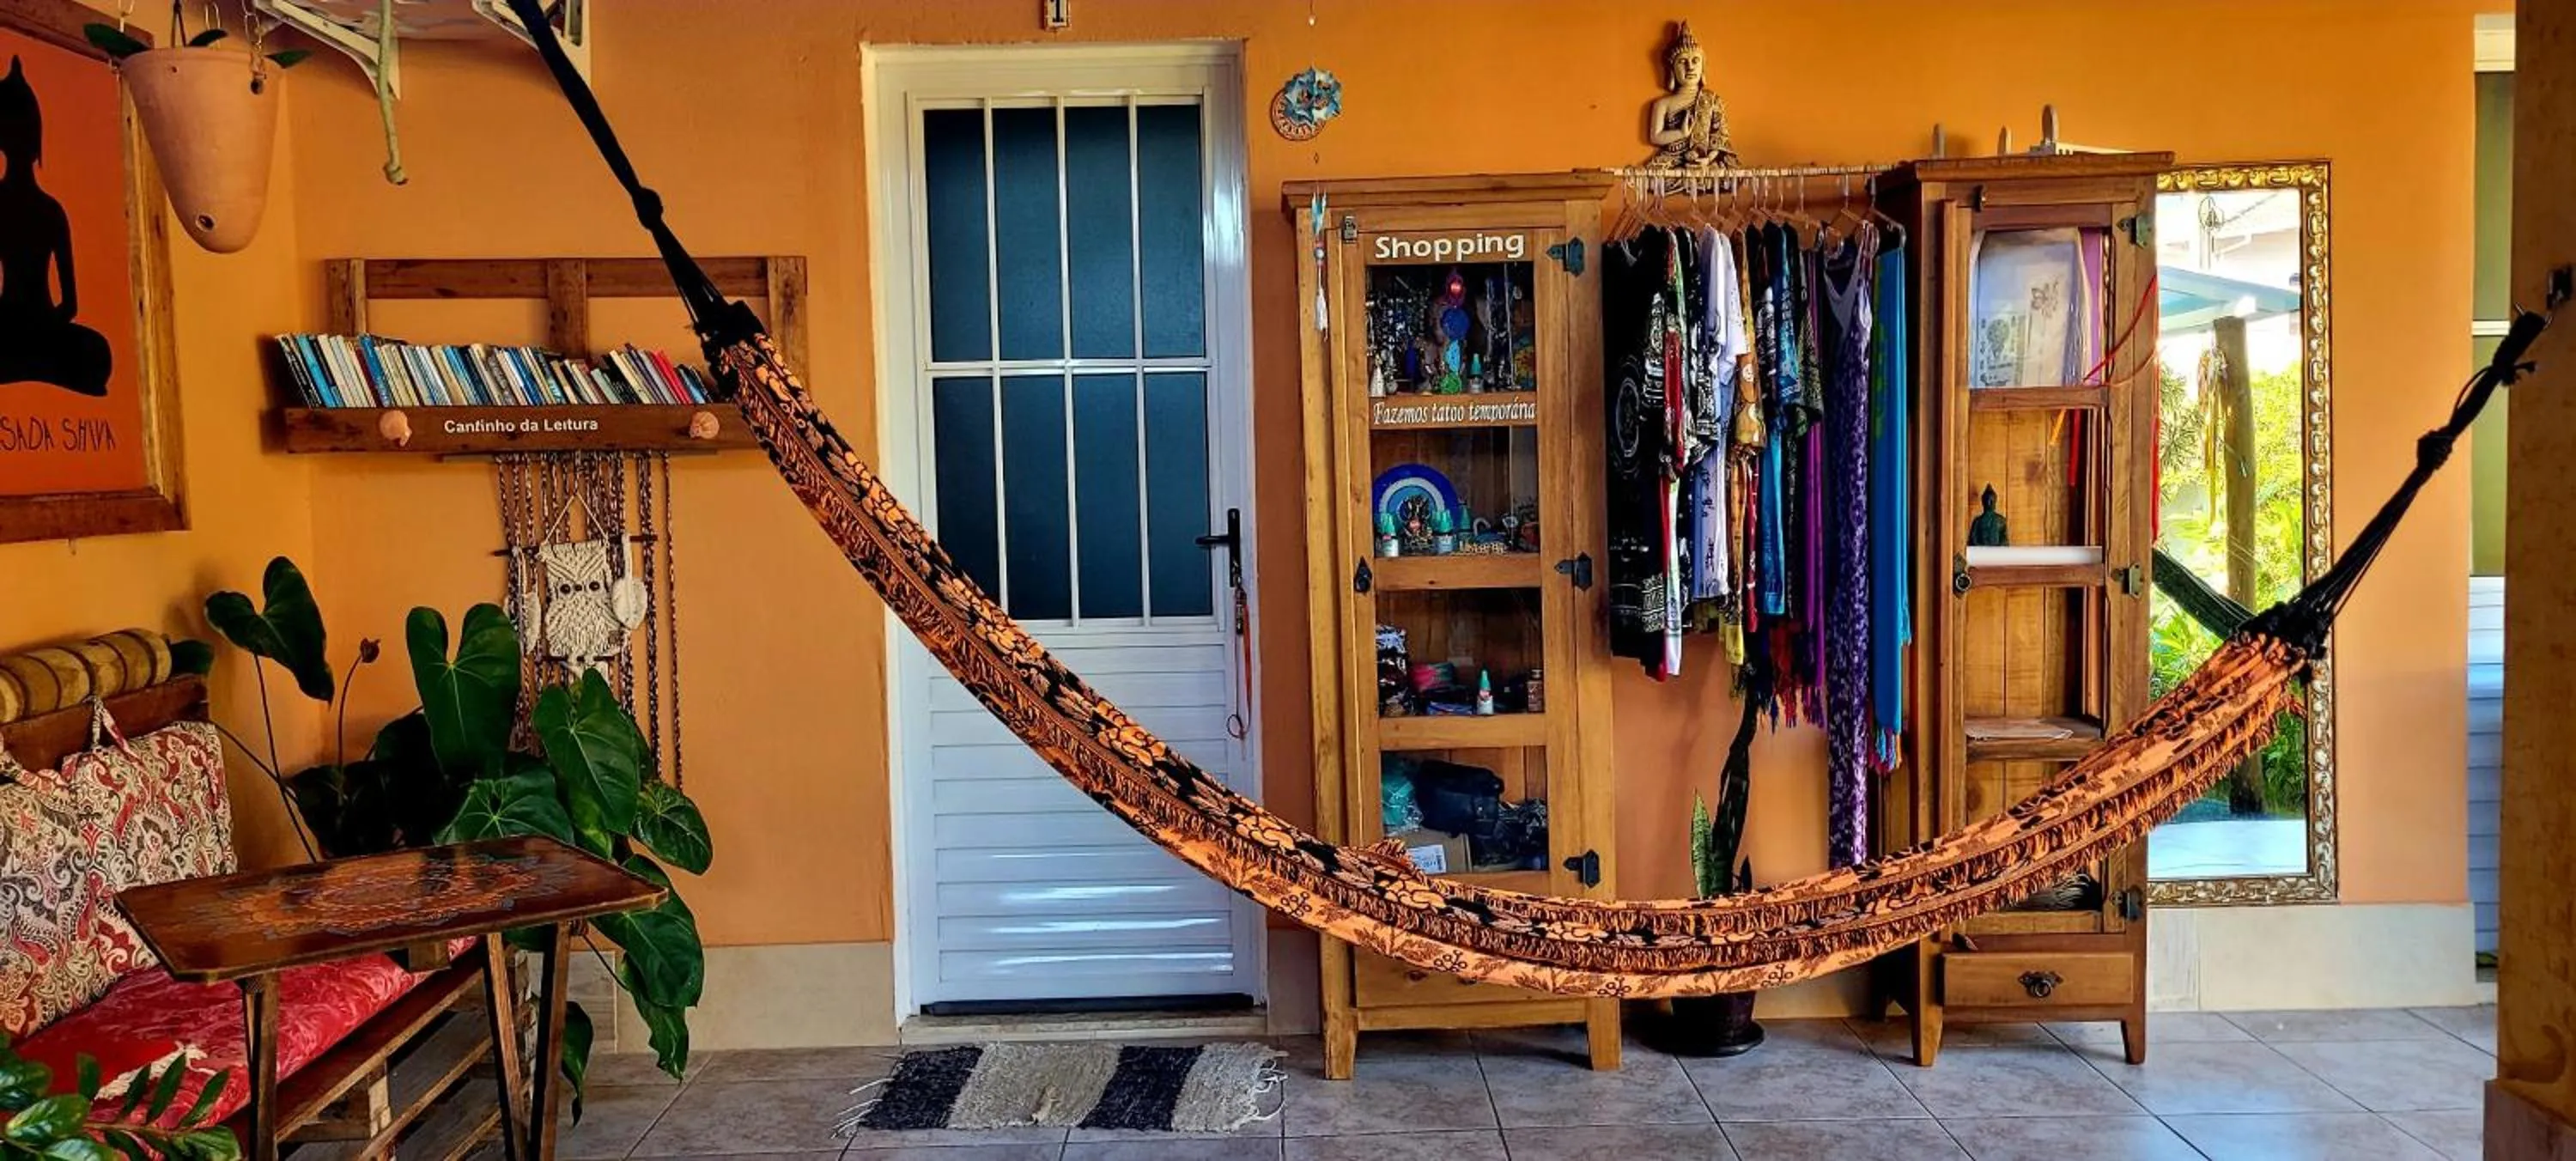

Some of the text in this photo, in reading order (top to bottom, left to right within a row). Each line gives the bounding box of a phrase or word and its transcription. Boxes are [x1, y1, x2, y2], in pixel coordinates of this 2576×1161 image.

[1375, 233, 1525, 262] Shopping
[444, 418, 598, 434] Cantinho da Leitura
[1374, 401, 1428, 425] Fazemos
[1431, 403, 1464, 422] tatoo
[62, 417, 117, 452] SHIVA
